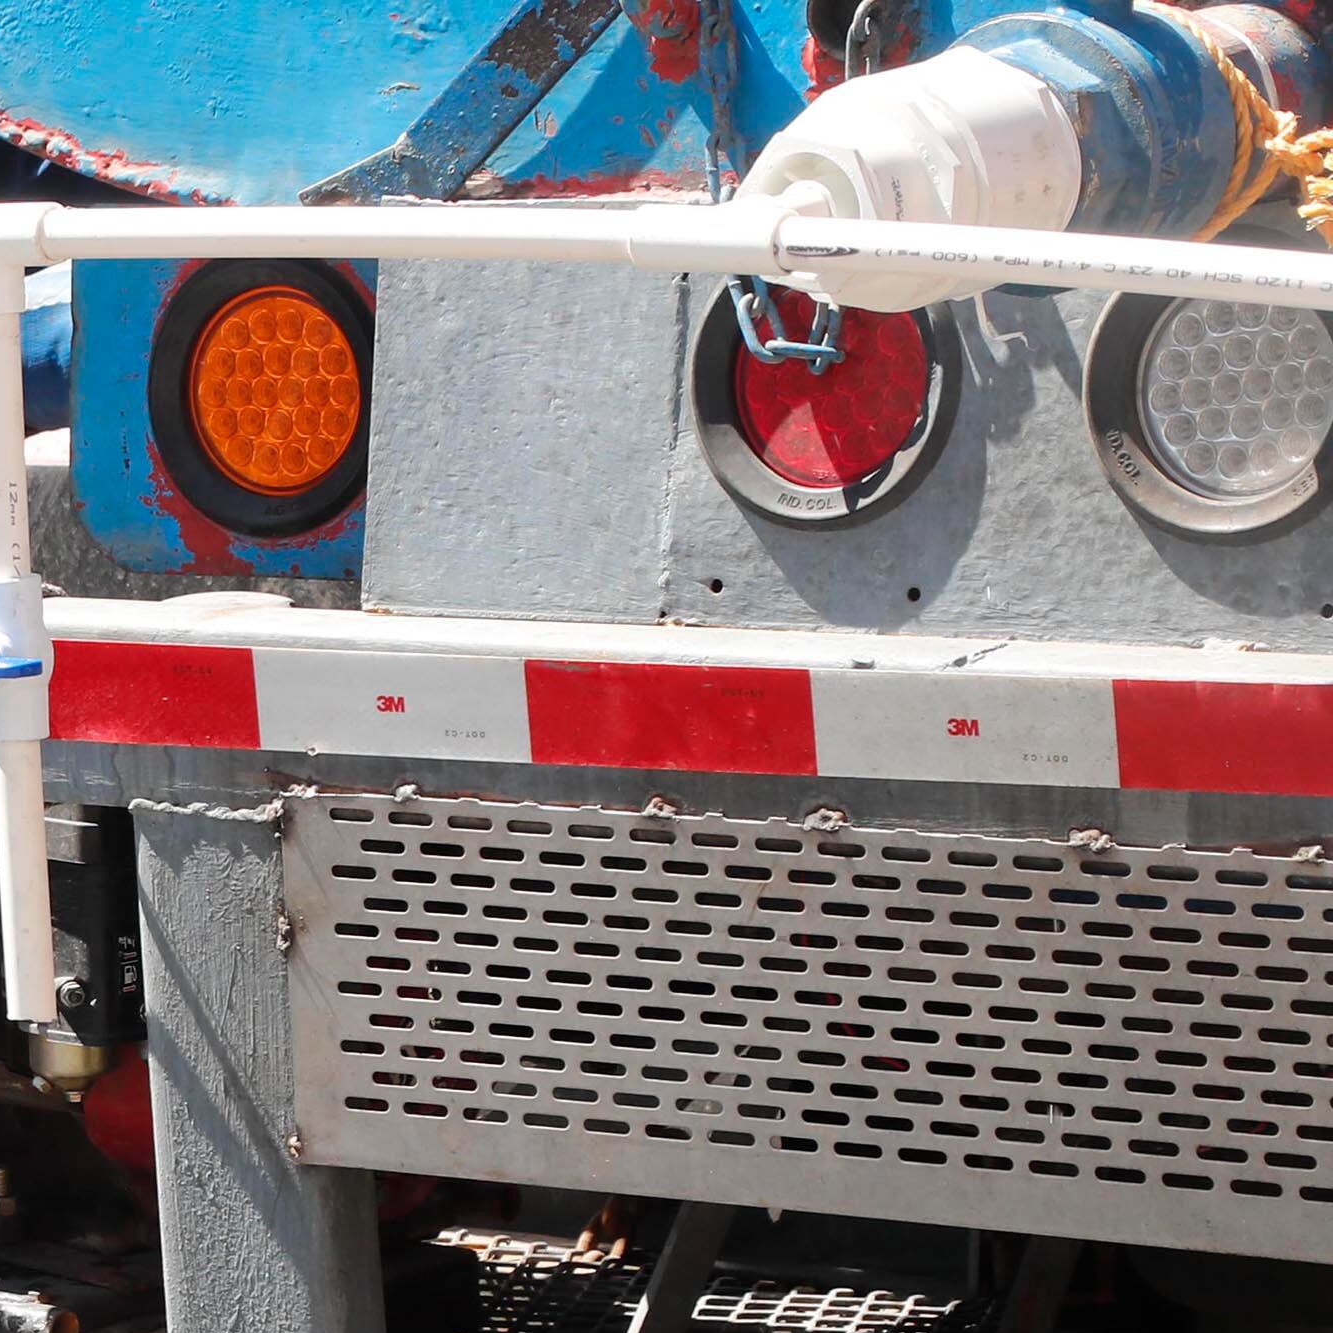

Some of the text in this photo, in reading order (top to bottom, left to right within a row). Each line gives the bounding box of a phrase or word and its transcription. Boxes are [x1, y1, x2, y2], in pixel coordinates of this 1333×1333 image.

[1165, 267, 1191, 279] 40
[1204, 271, 1243, 284] SCH
[1255, 275, 1303, 289] 1120
[376, 695, 406, 713] 3M
[947, 718, 980, 737] 3M
